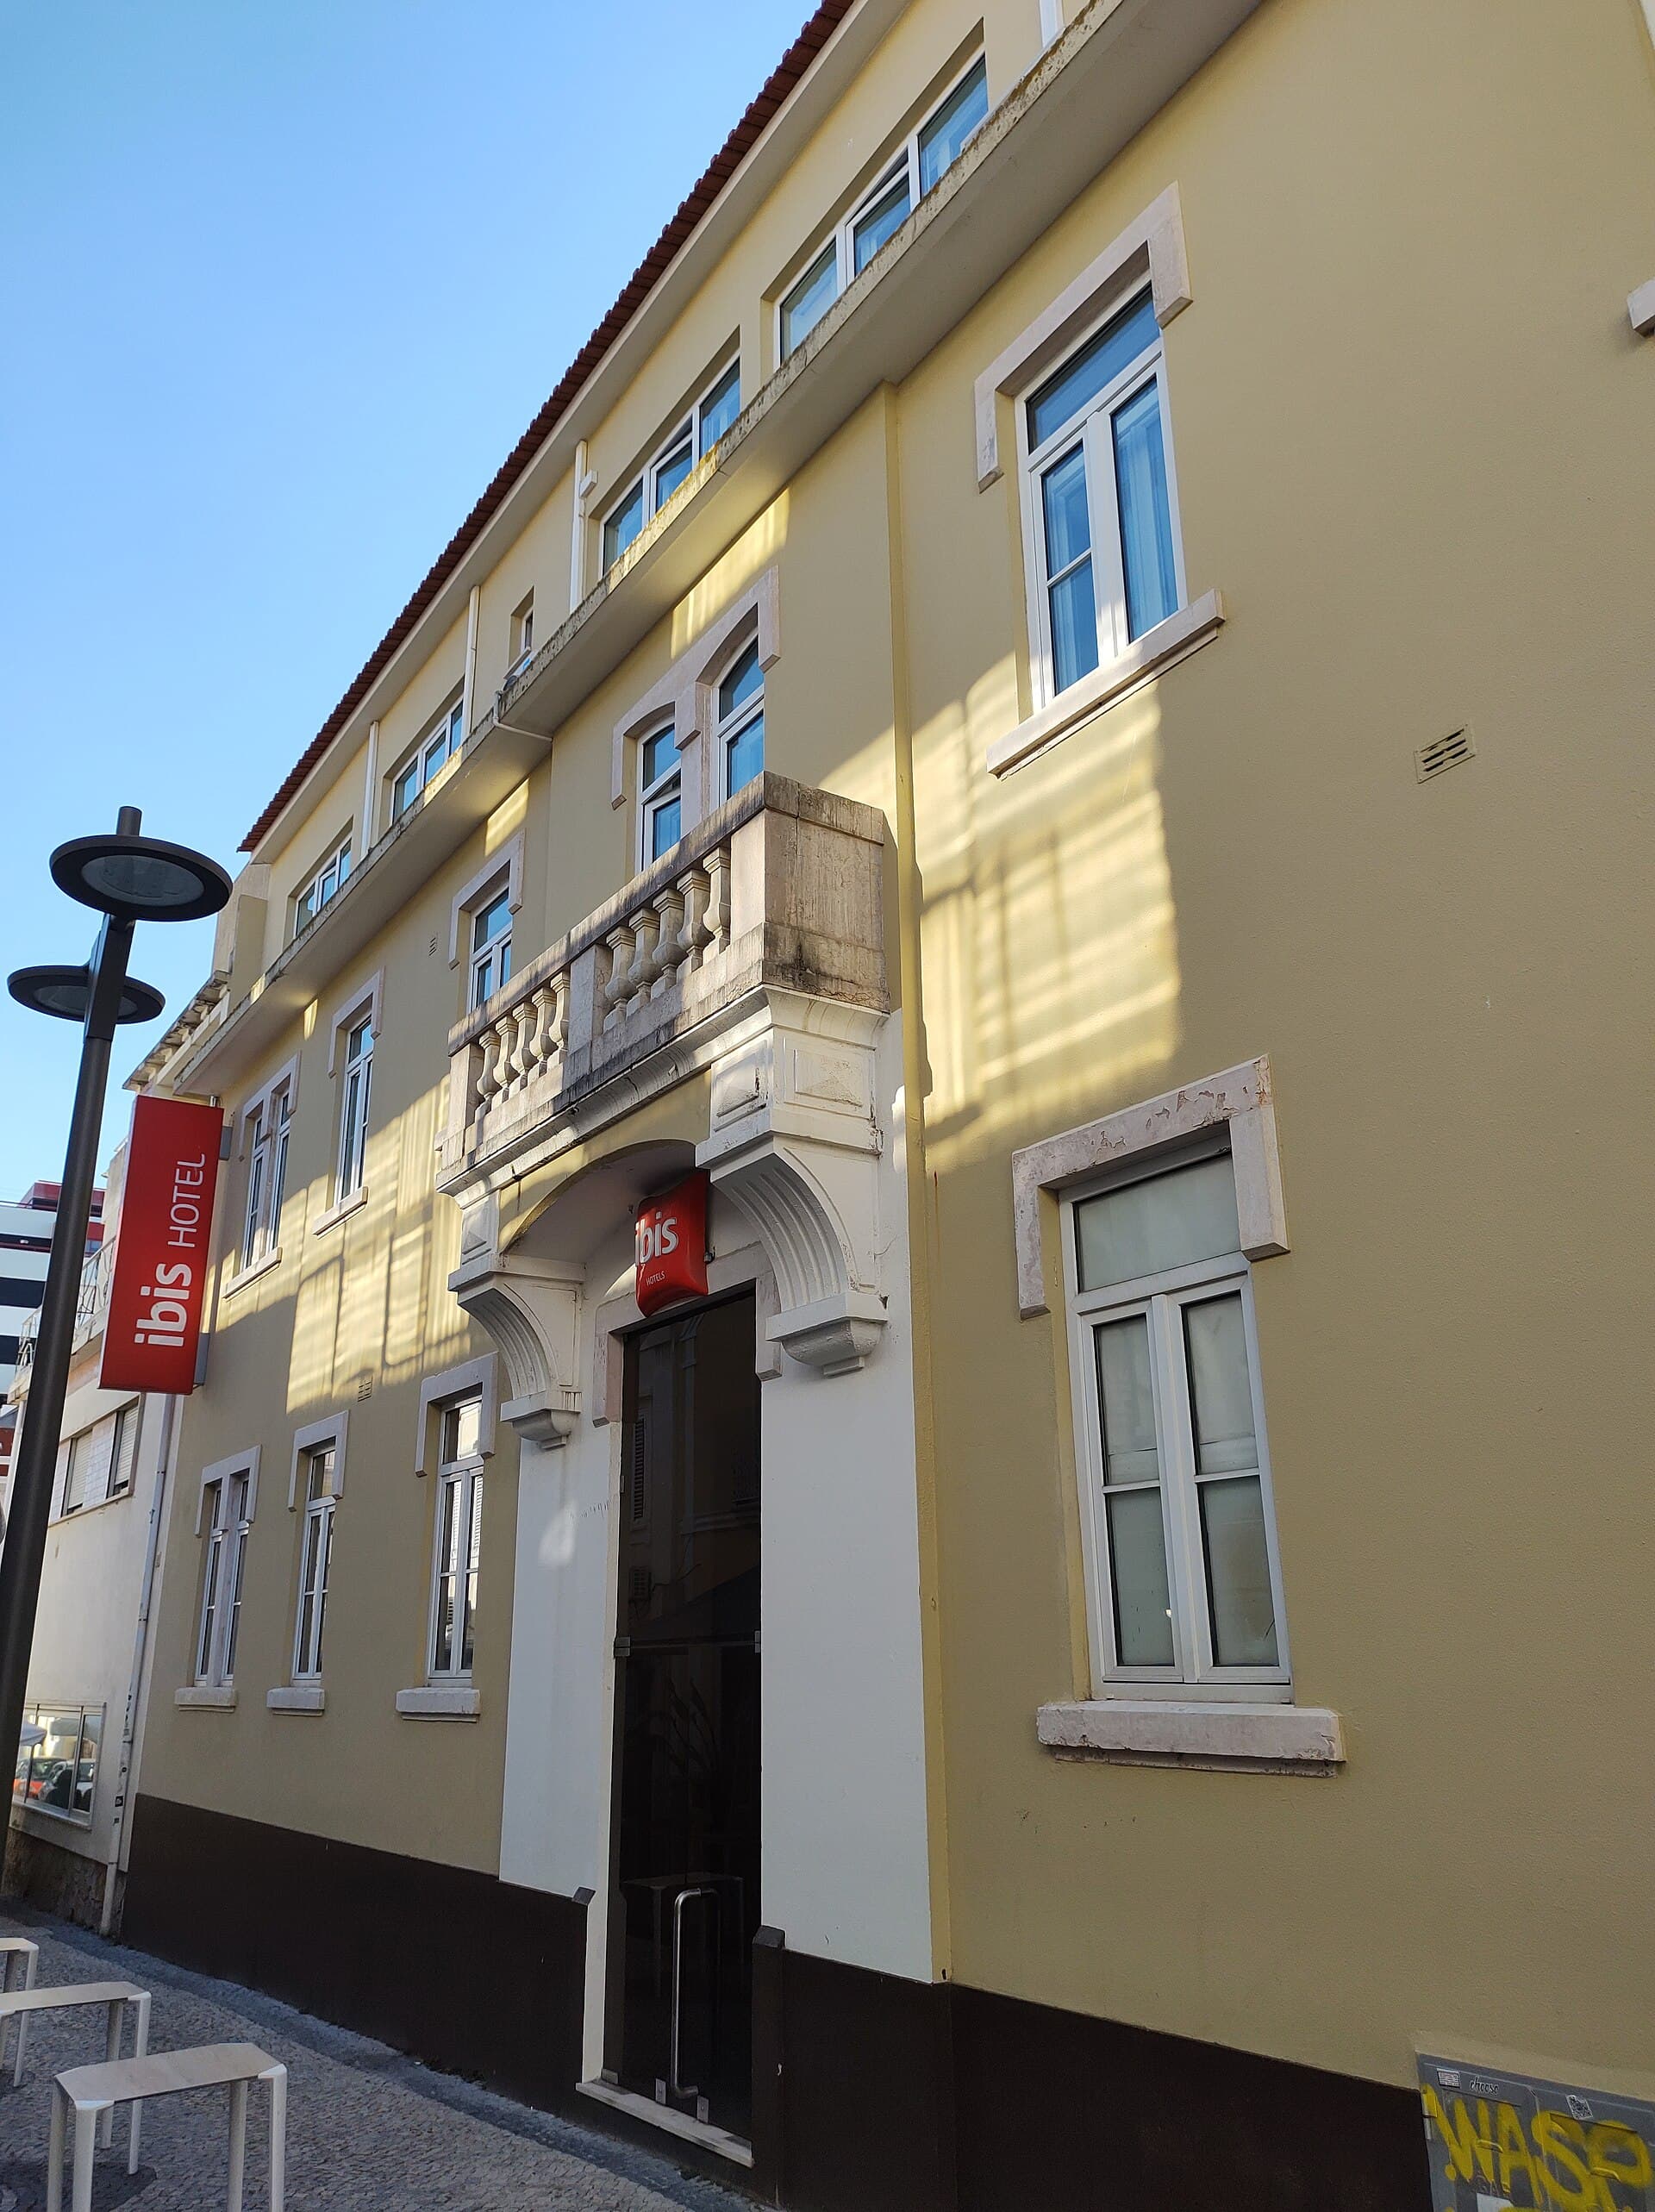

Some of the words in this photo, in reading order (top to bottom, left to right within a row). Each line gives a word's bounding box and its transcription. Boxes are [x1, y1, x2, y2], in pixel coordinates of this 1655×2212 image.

[134, 1263, 192, 1347] ibis
[168, 1153, 206, 1247] HOTEL
[646, 1271, 665, 1285] HOTELS
